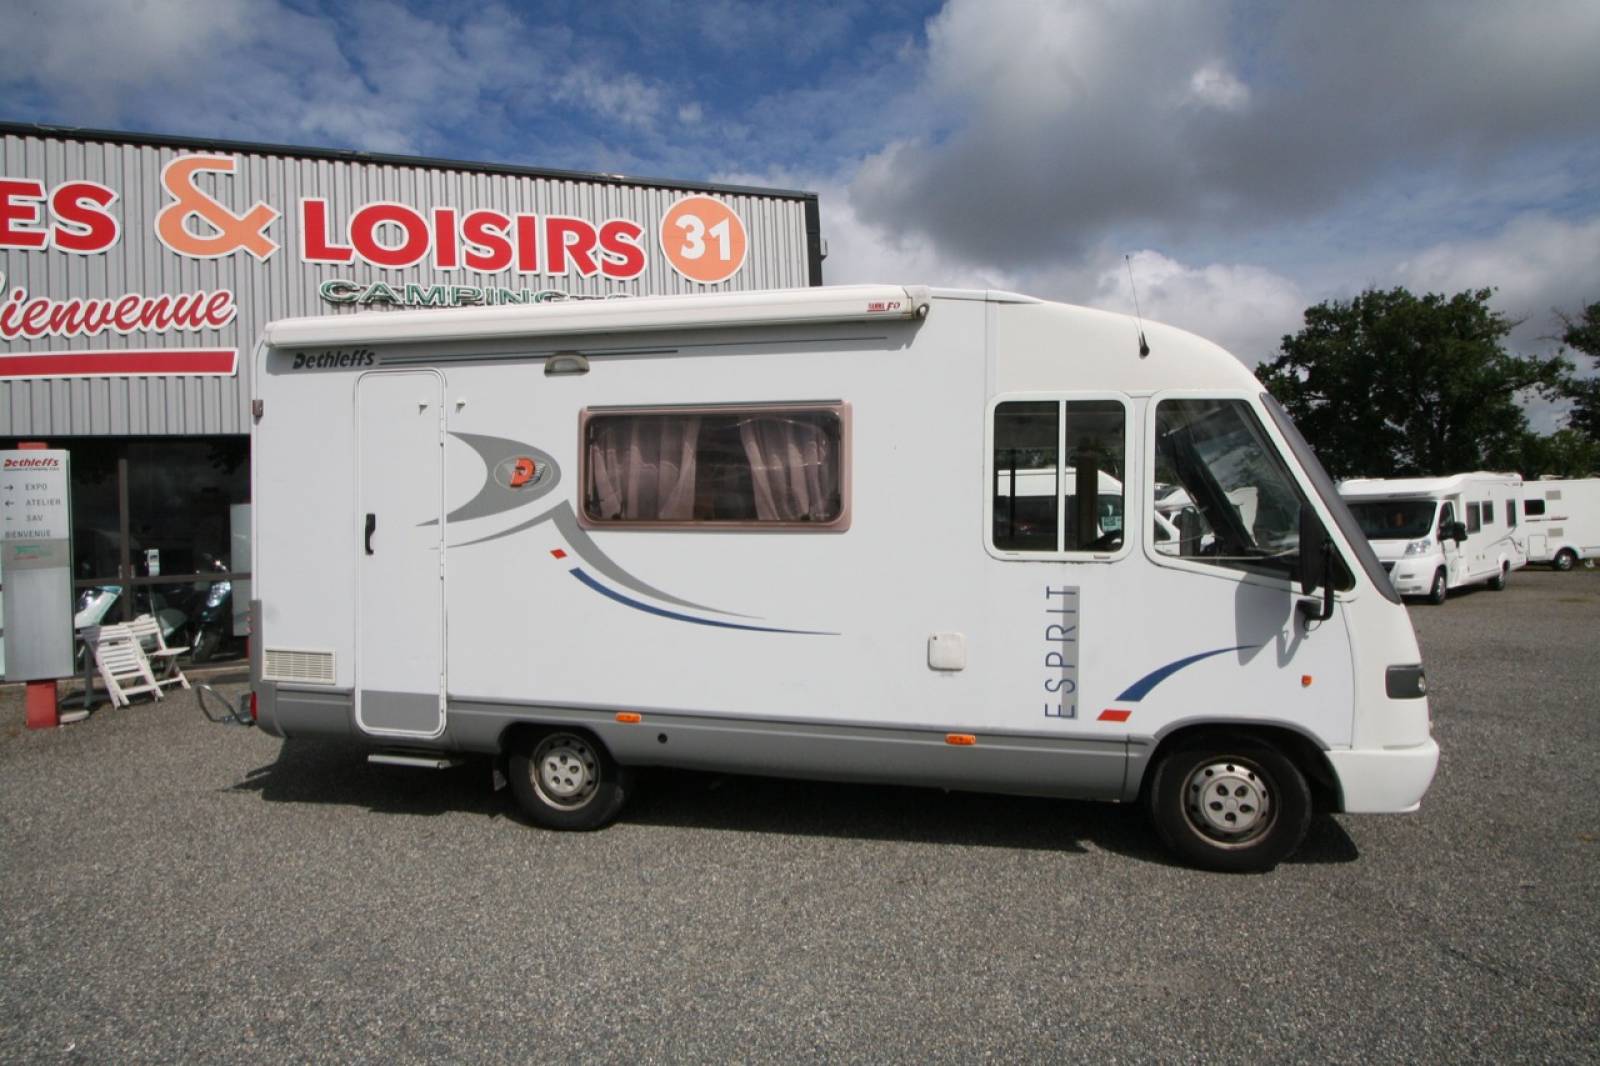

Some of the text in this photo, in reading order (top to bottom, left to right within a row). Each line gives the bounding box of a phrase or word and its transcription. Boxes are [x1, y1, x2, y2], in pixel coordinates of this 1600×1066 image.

[154, 154, 281, 263] &
[300, 196, 646, 282] LOISIRS
[675, 213, 731, 261] 31
[0, 278, 237, 341] ienvenue
[292, 349, 376, 371] Dethleffs
[4, 457, 59, 467] Dethleffs
[25, 482, 48, 491] EXPO
[5, 529, 51, 538] BIENVENUE
[1045, 586, 1076, 719] ESPRIT
